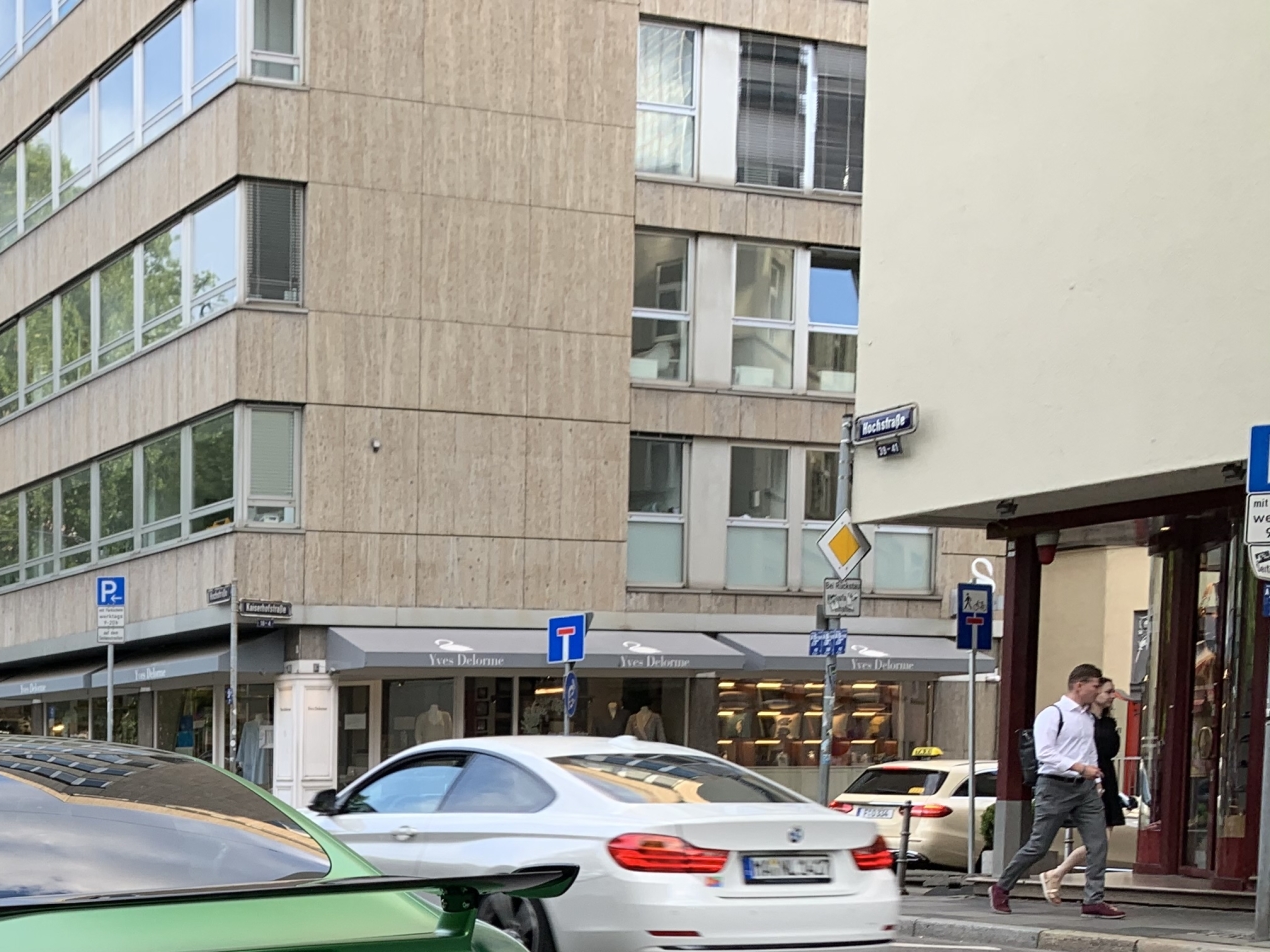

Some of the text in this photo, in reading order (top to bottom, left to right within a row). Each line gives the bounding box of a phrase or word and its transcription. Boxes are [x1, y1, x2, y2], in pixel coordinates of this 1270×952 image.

[862, 414, 906, 436] Hochstraße
[1253, 500, 1268, 508] mit
[101, 580, 118, 603] P
[245, 602, 287, 614] Kaiserhofstraße
[429, 653, 505, 667] Yves Delorme
[620, 655, 691, 668] Yves Delorme
[851, 658, 915, 670] Yves Delorme
